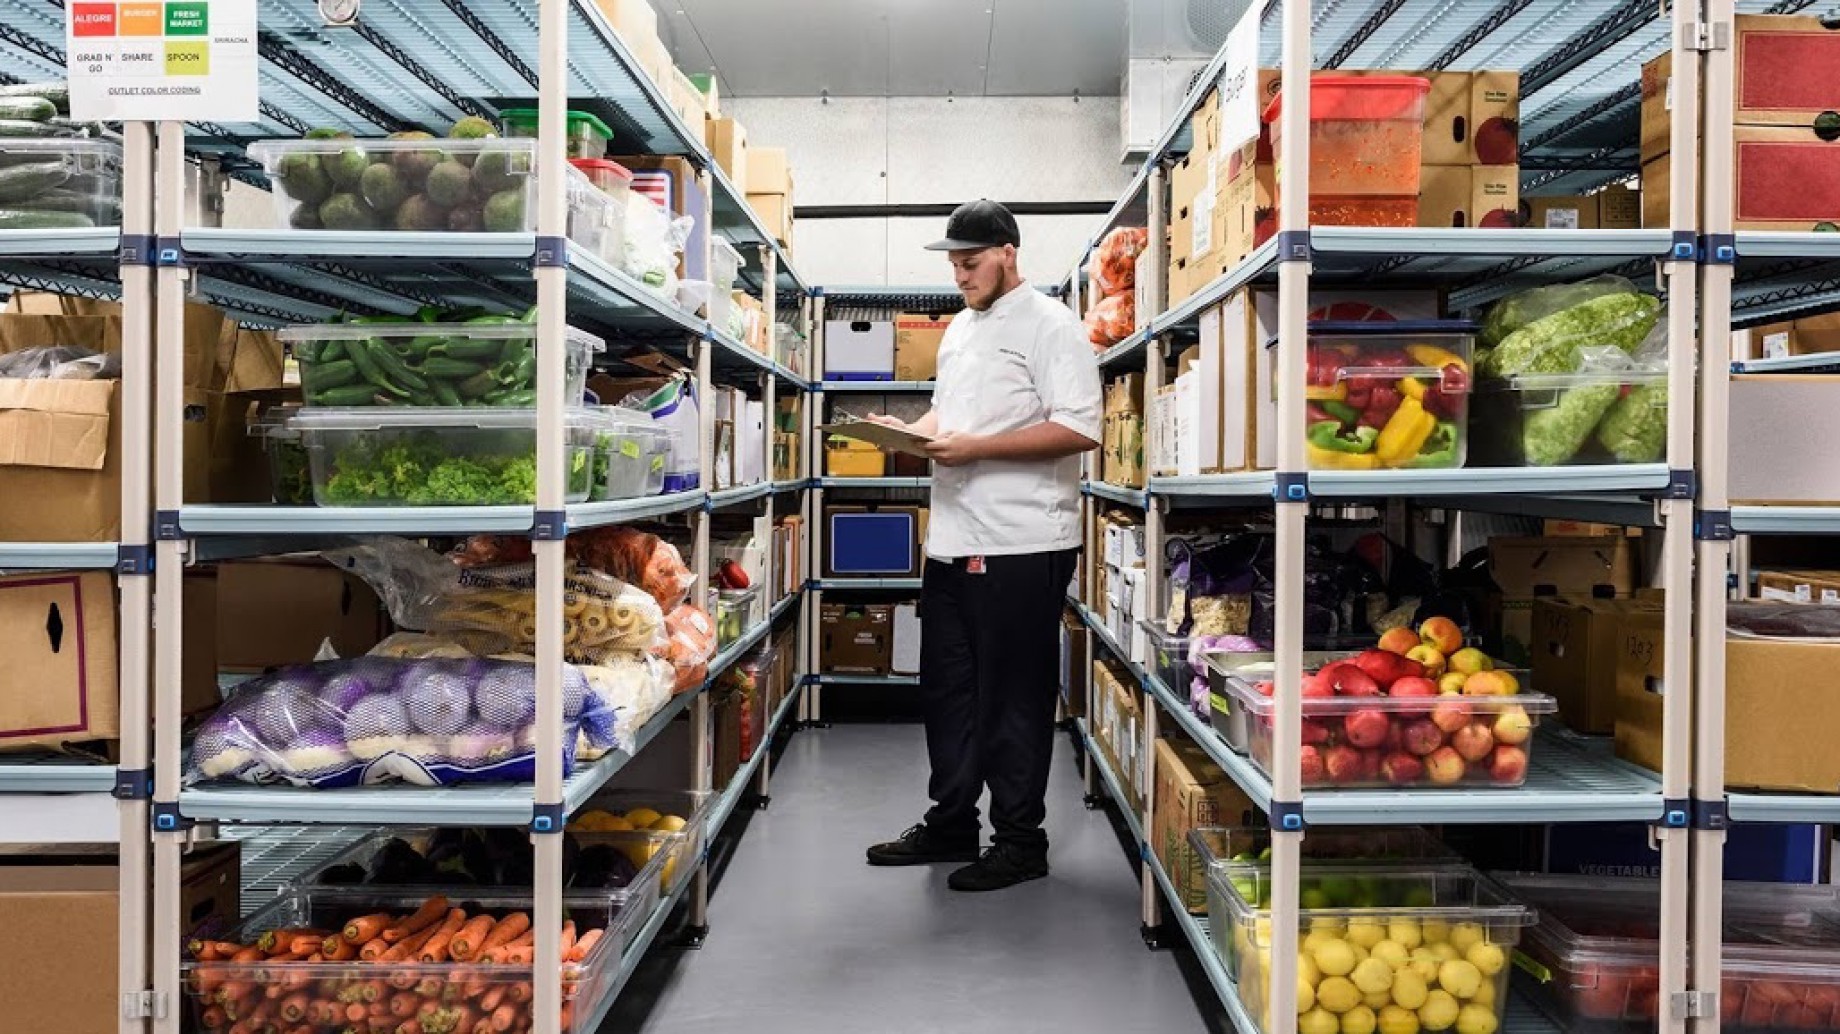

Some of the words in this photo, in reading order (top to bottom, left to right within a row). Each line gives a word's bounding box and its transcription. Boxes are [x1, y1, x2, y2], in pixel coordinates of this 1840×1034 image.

[173, 10, 200, 18] FRESH
[74, 14, 112, 23] ALEGRE
[169, 19, 203, 27] MARKET
[76, 53, 103, 62] GRAB
[121, 53, 154, 62] SHARE
[167, 53, 200, 61] SPOON
[89, 65, 103, 73] GO
[108, 87, 139, 95] OUTLET
[141, 87, 169, 95] COLOR
[170, 87, 201, 95] CODING
